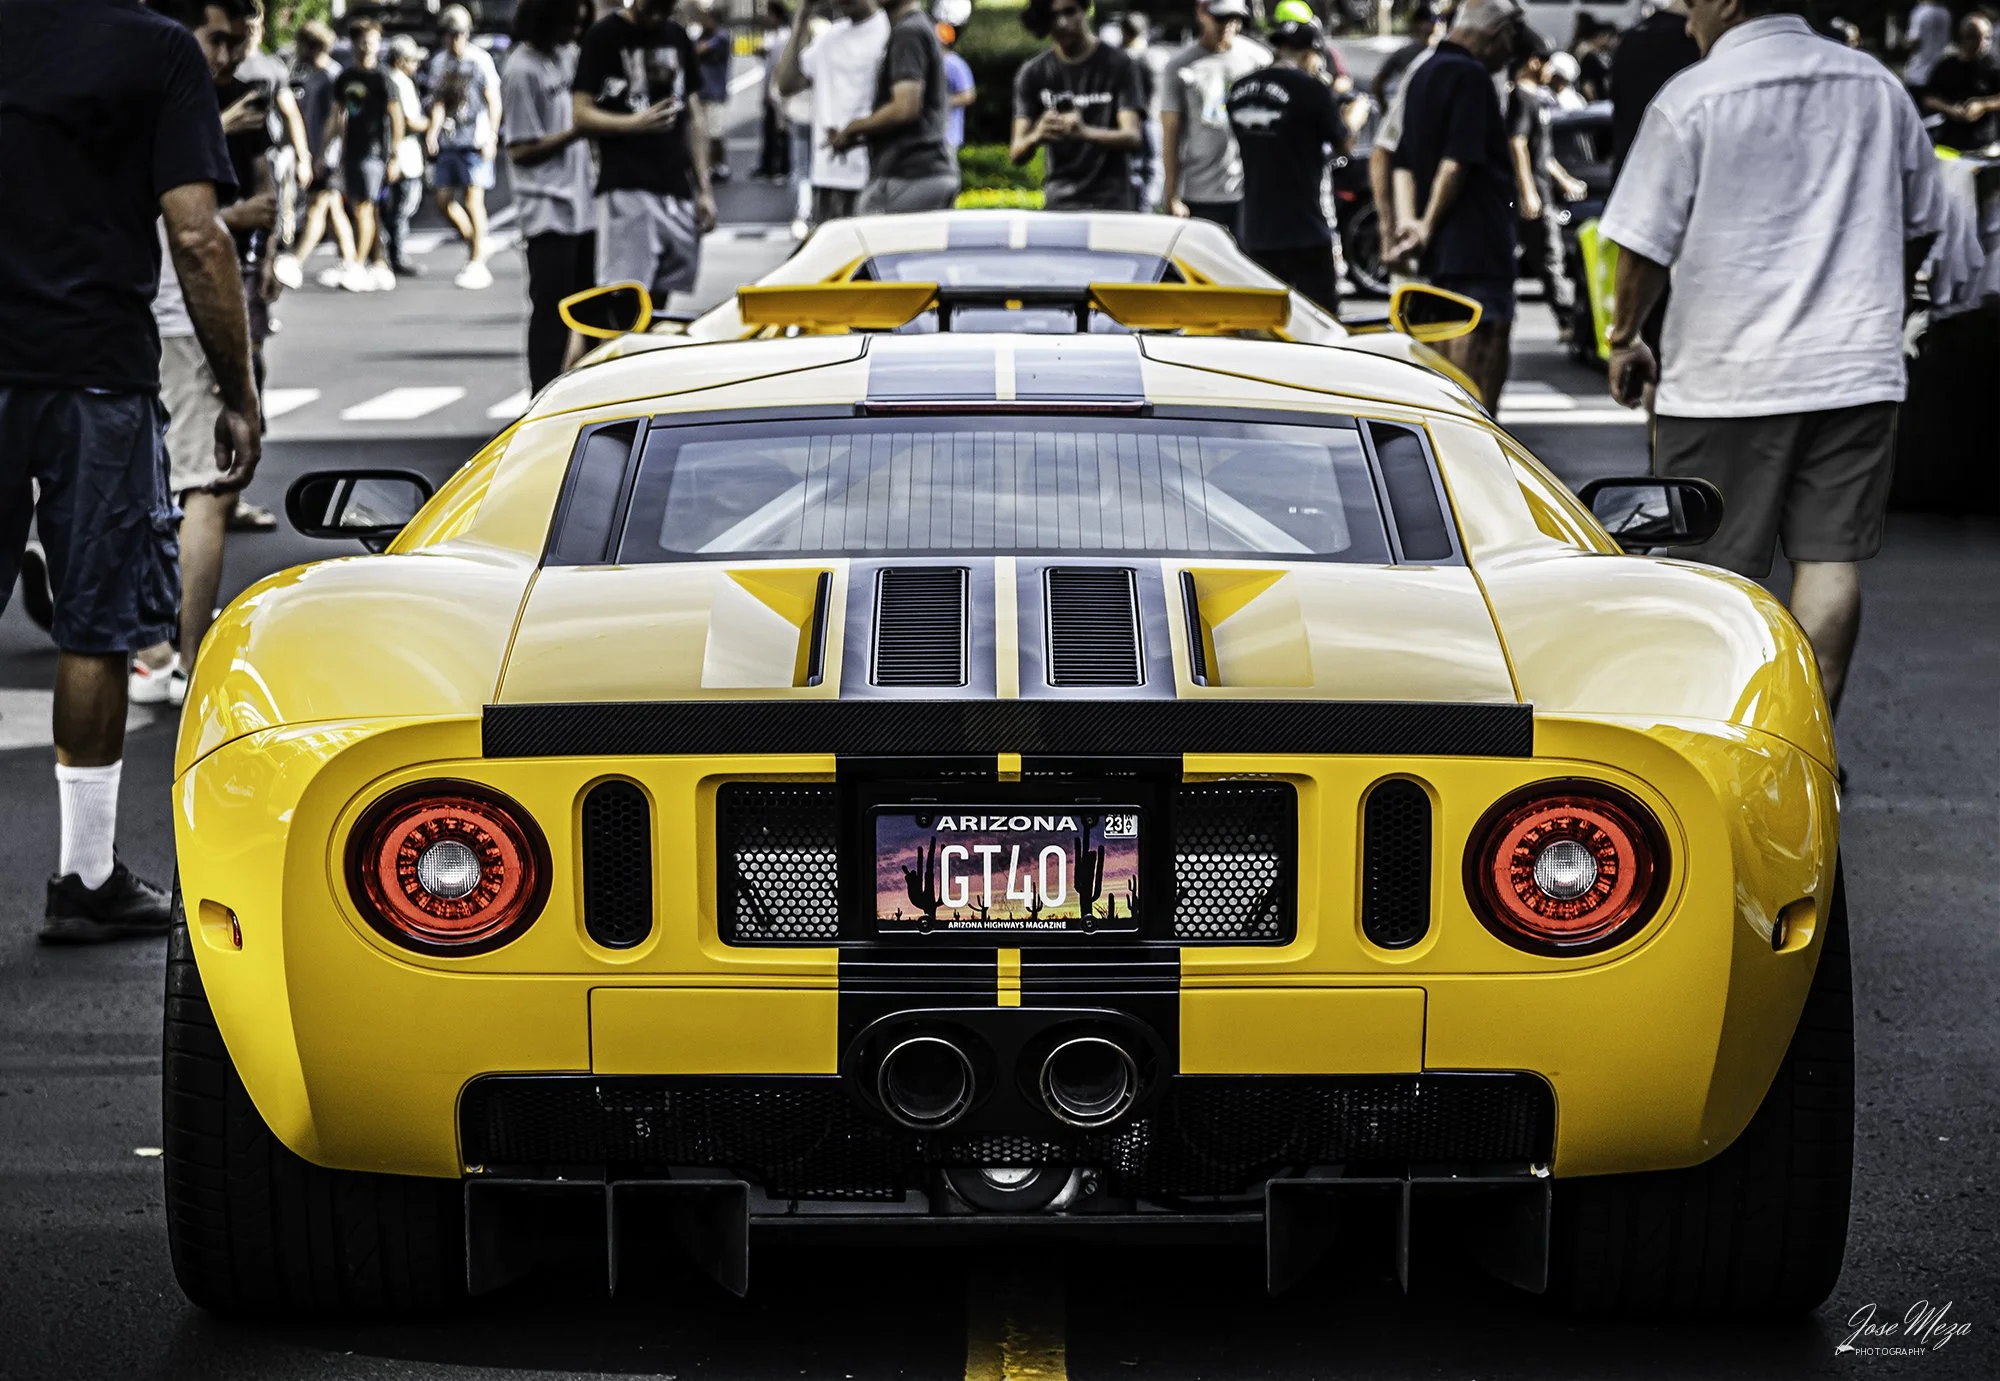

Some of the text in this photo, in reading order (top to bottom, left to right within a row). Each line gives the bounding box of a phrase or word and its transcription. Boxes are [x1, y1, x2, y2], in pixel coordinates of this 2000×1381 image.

[936, 815, 1078, 831] ARIZONA
[1105, 815, 1123, 831] 23
[940, 844, 1067, 909] GT40
[948, 921, 1067, 929] ARIZONA HIGHWAYS MAGAZINE
